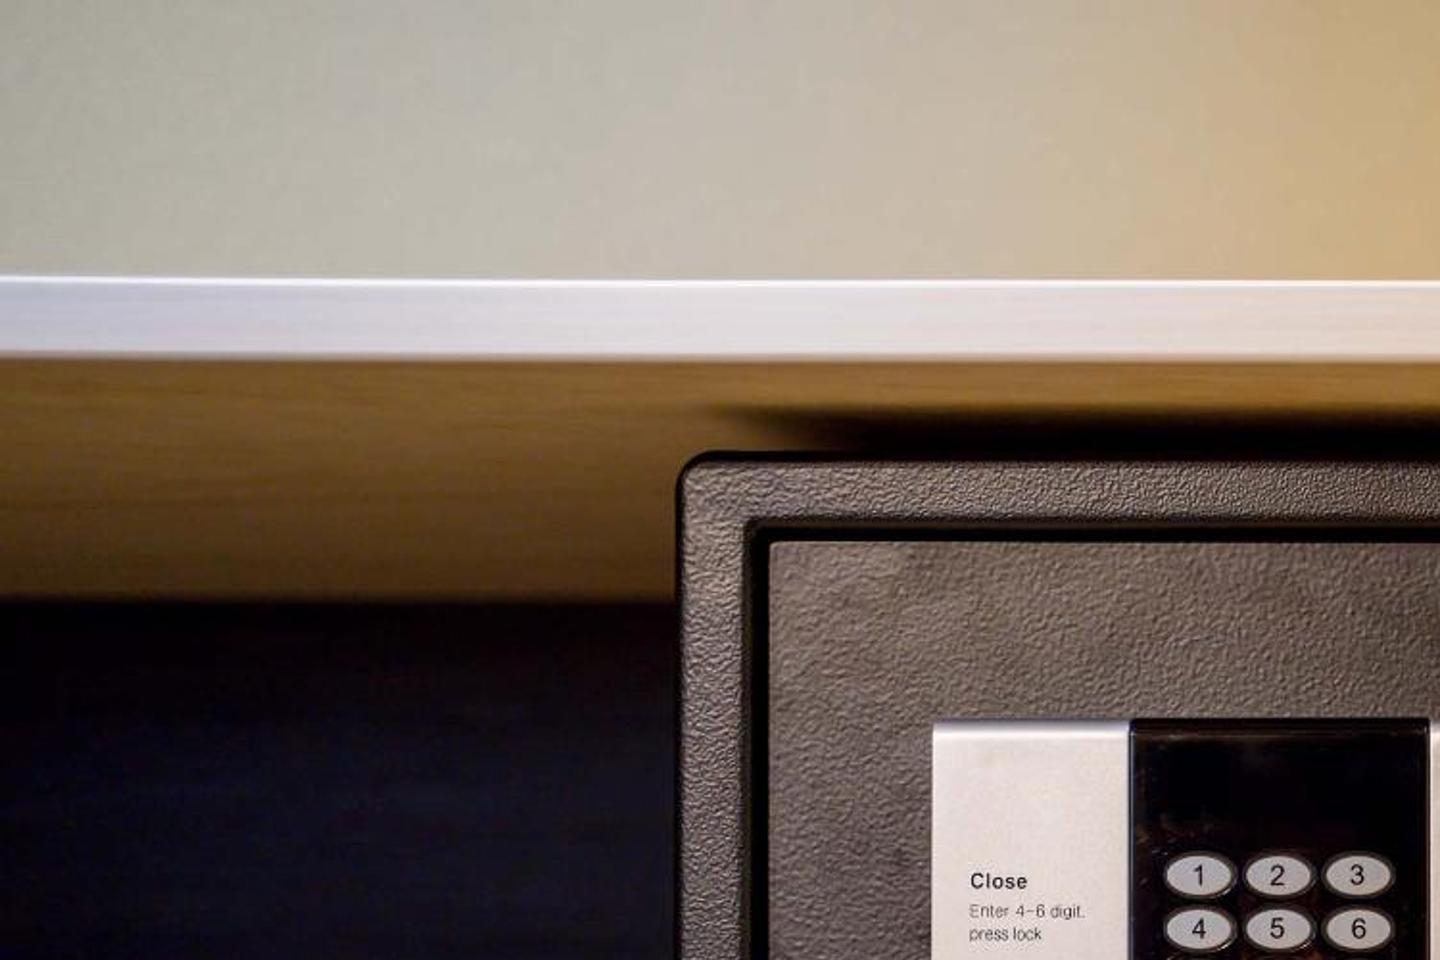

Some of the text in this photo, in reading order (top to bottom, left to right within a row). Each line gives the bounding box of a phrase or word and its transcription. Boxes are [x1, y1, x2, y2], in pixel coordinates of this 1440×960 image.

[970, 872, 1028, 889] Close
[1193, 864, 1205, 886] 1
[1270, 865, 1285, 886] 2
[1350, 865, 1365, 886] 3
[969, 904, 1009, 918] Enter
[1015, 904, 1046, 918] 4-6
[969, 928, 1042, 943] press lock
[1192, 918, 1206, 939] 4
[1270, 917, 1285, 939] 5
[1351, 918, 1366, 939] 6
